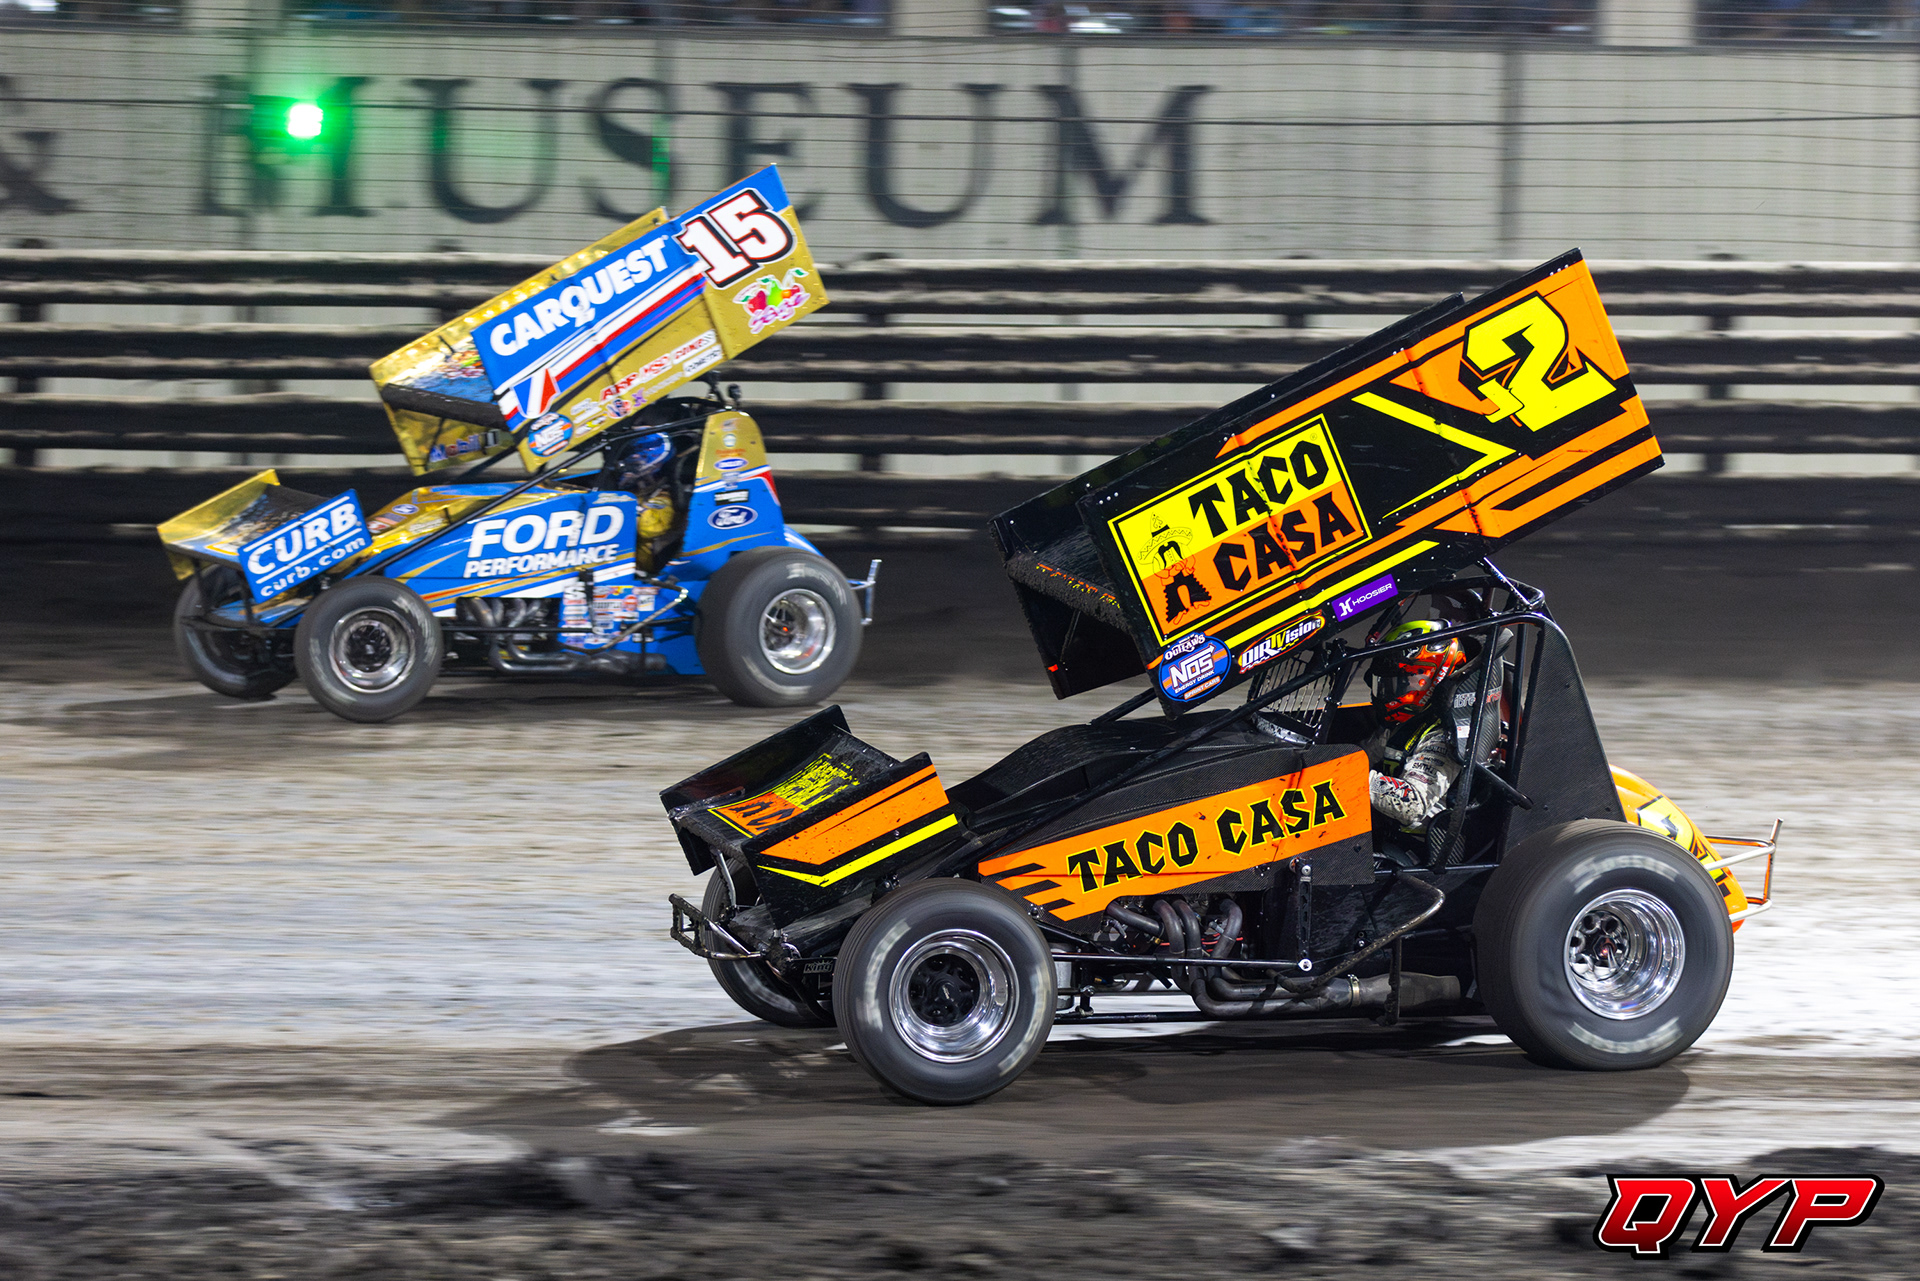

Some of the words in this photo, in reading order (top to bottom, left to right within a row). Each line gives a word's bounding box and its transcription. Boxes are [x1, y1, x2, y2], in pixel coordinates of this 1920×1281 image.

[674, 189, 795, 288] 15
[490, 237, 669, 357] CARQUEST
[1466, 295, 1617, 433] 2
[1188, 440, 1329, 539] TACO
[247, 503, 358, 575] CURB
[260, 537, 366, 597] curb.com
[463, 544, 620, 579] PERFORMANCE
[466, 506, 625, 558] FORD
[1213, 491, 1356, 592] CASA
[1352, 583, 1393, 606] HOOSIER
[1168, 643, 1217, 689] NOS
[1174, 679, 1197, 694] ENERGY
[1196, 670, 1215, 686] DRINK
[1067, 821, 1200, 894] TACO
[1215, 779, 1348, 856] CASA
